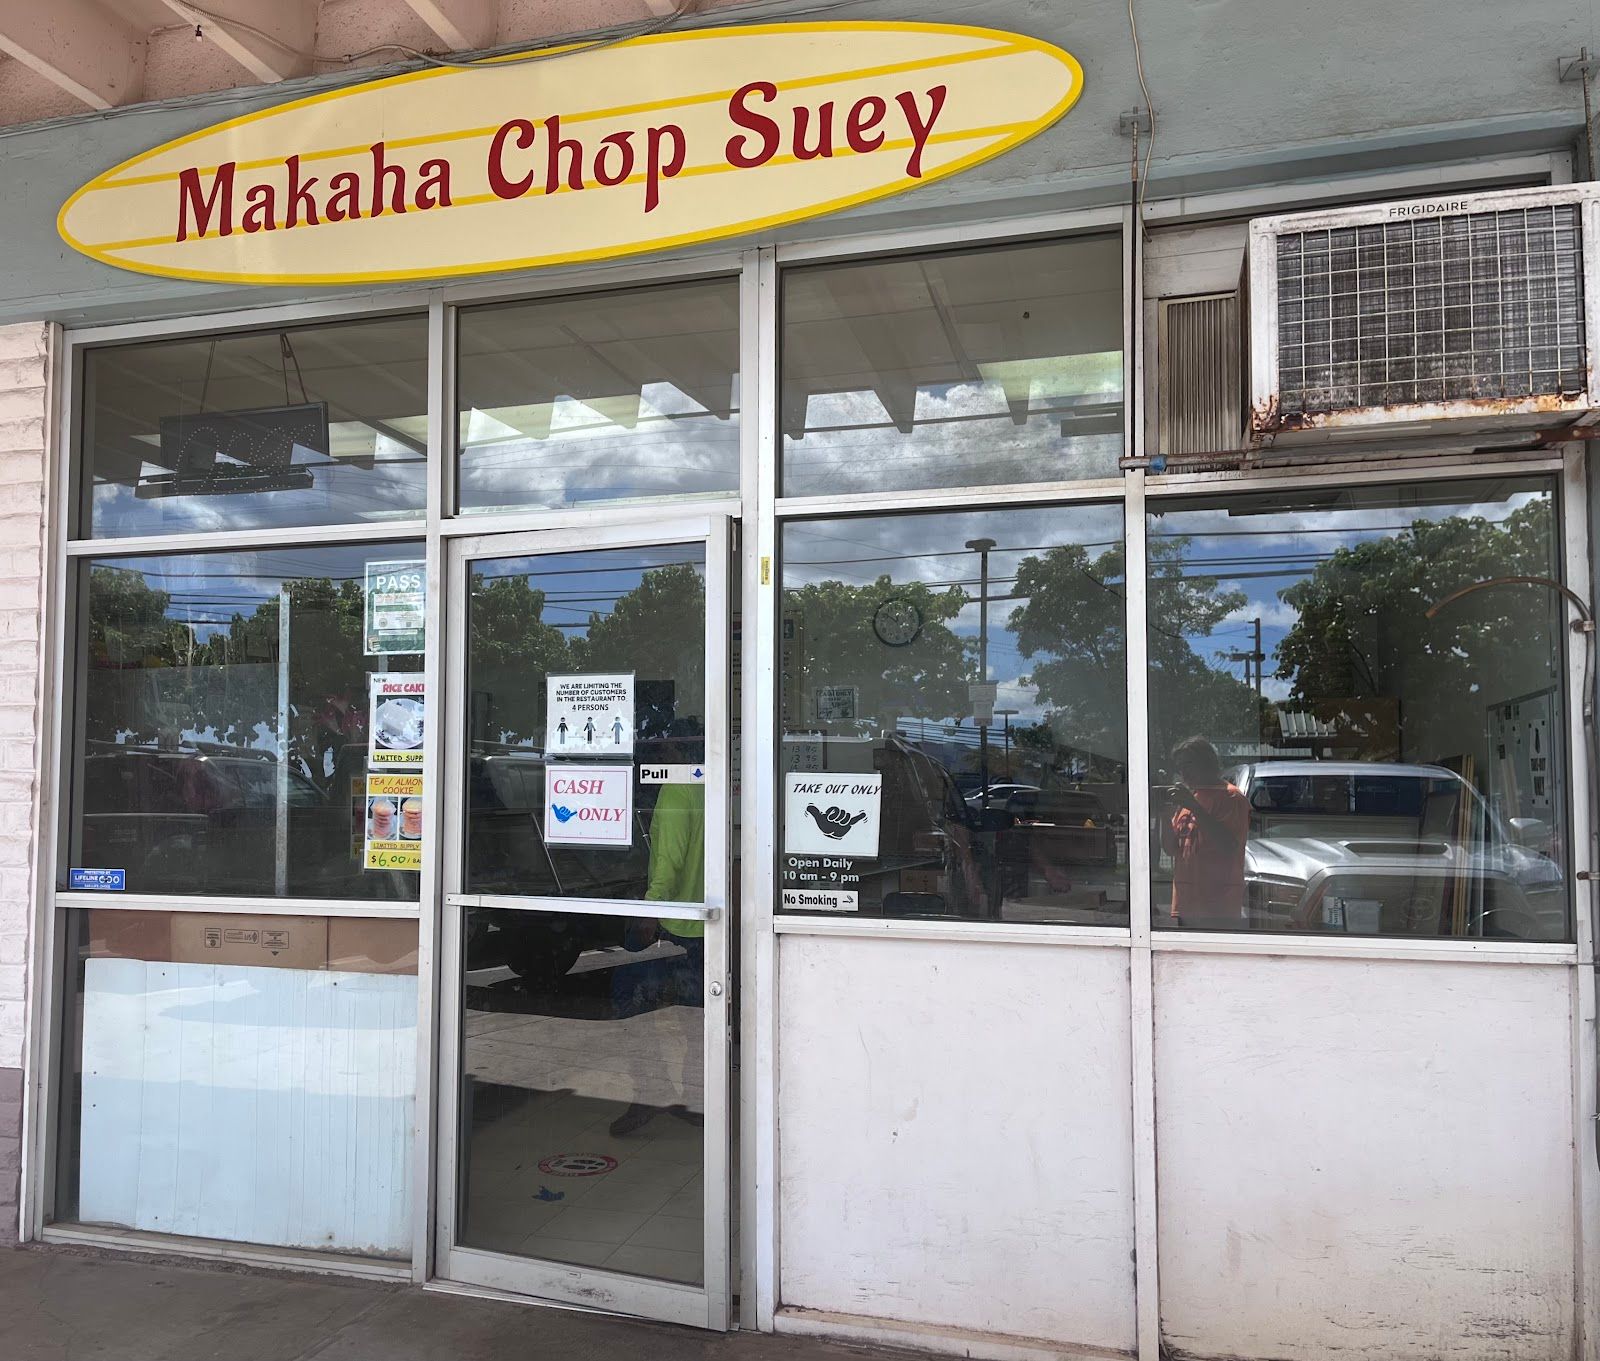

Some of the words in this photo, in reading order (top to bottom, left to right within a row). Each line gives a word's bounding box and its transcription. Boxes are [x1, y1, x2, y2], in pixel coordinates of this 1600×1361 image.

[176, 142, 453, 242] Makaha
[487, 114, 686, 214] Chop
[724, 81, 947, 179] Suey
[1389, 201, 1468, 217] FRIGIDAIRE
[376, 574, 421, 590] PASS
[382, 683, 402, 693] RICE
[583, 682, 610, 690] LIMITING
[577, 703, 609, 711] PERSONS
[641, 769, 668, 779] Pull
[369, 777, 385, 786] TEA
[387, 778, 393, 786] /
[395, 777, 423, 786] ALMON
[553, 779, 605, 795] CASH
[382, 786, 414, 795] COOKIE
[793, 783, 823, 794] TAKE
[825, 783, 849, 795] OUT
[851, 784, 881, 795] ONLY
[578, 807, 626, 822] ONLY
[400, 842, 420, 850] SUPPLY
[788, 857, 820, 870] Open
[823, 857, 853, 871] Daily
[783, 870, 797, 880] 10
[799, 871, 818, 881] am
[829, 871, 838, 881] 9
[840, 873, 860, 884] pm
[784, 893, 796, 904] No
[798, 893, 838, 908] Smoking
